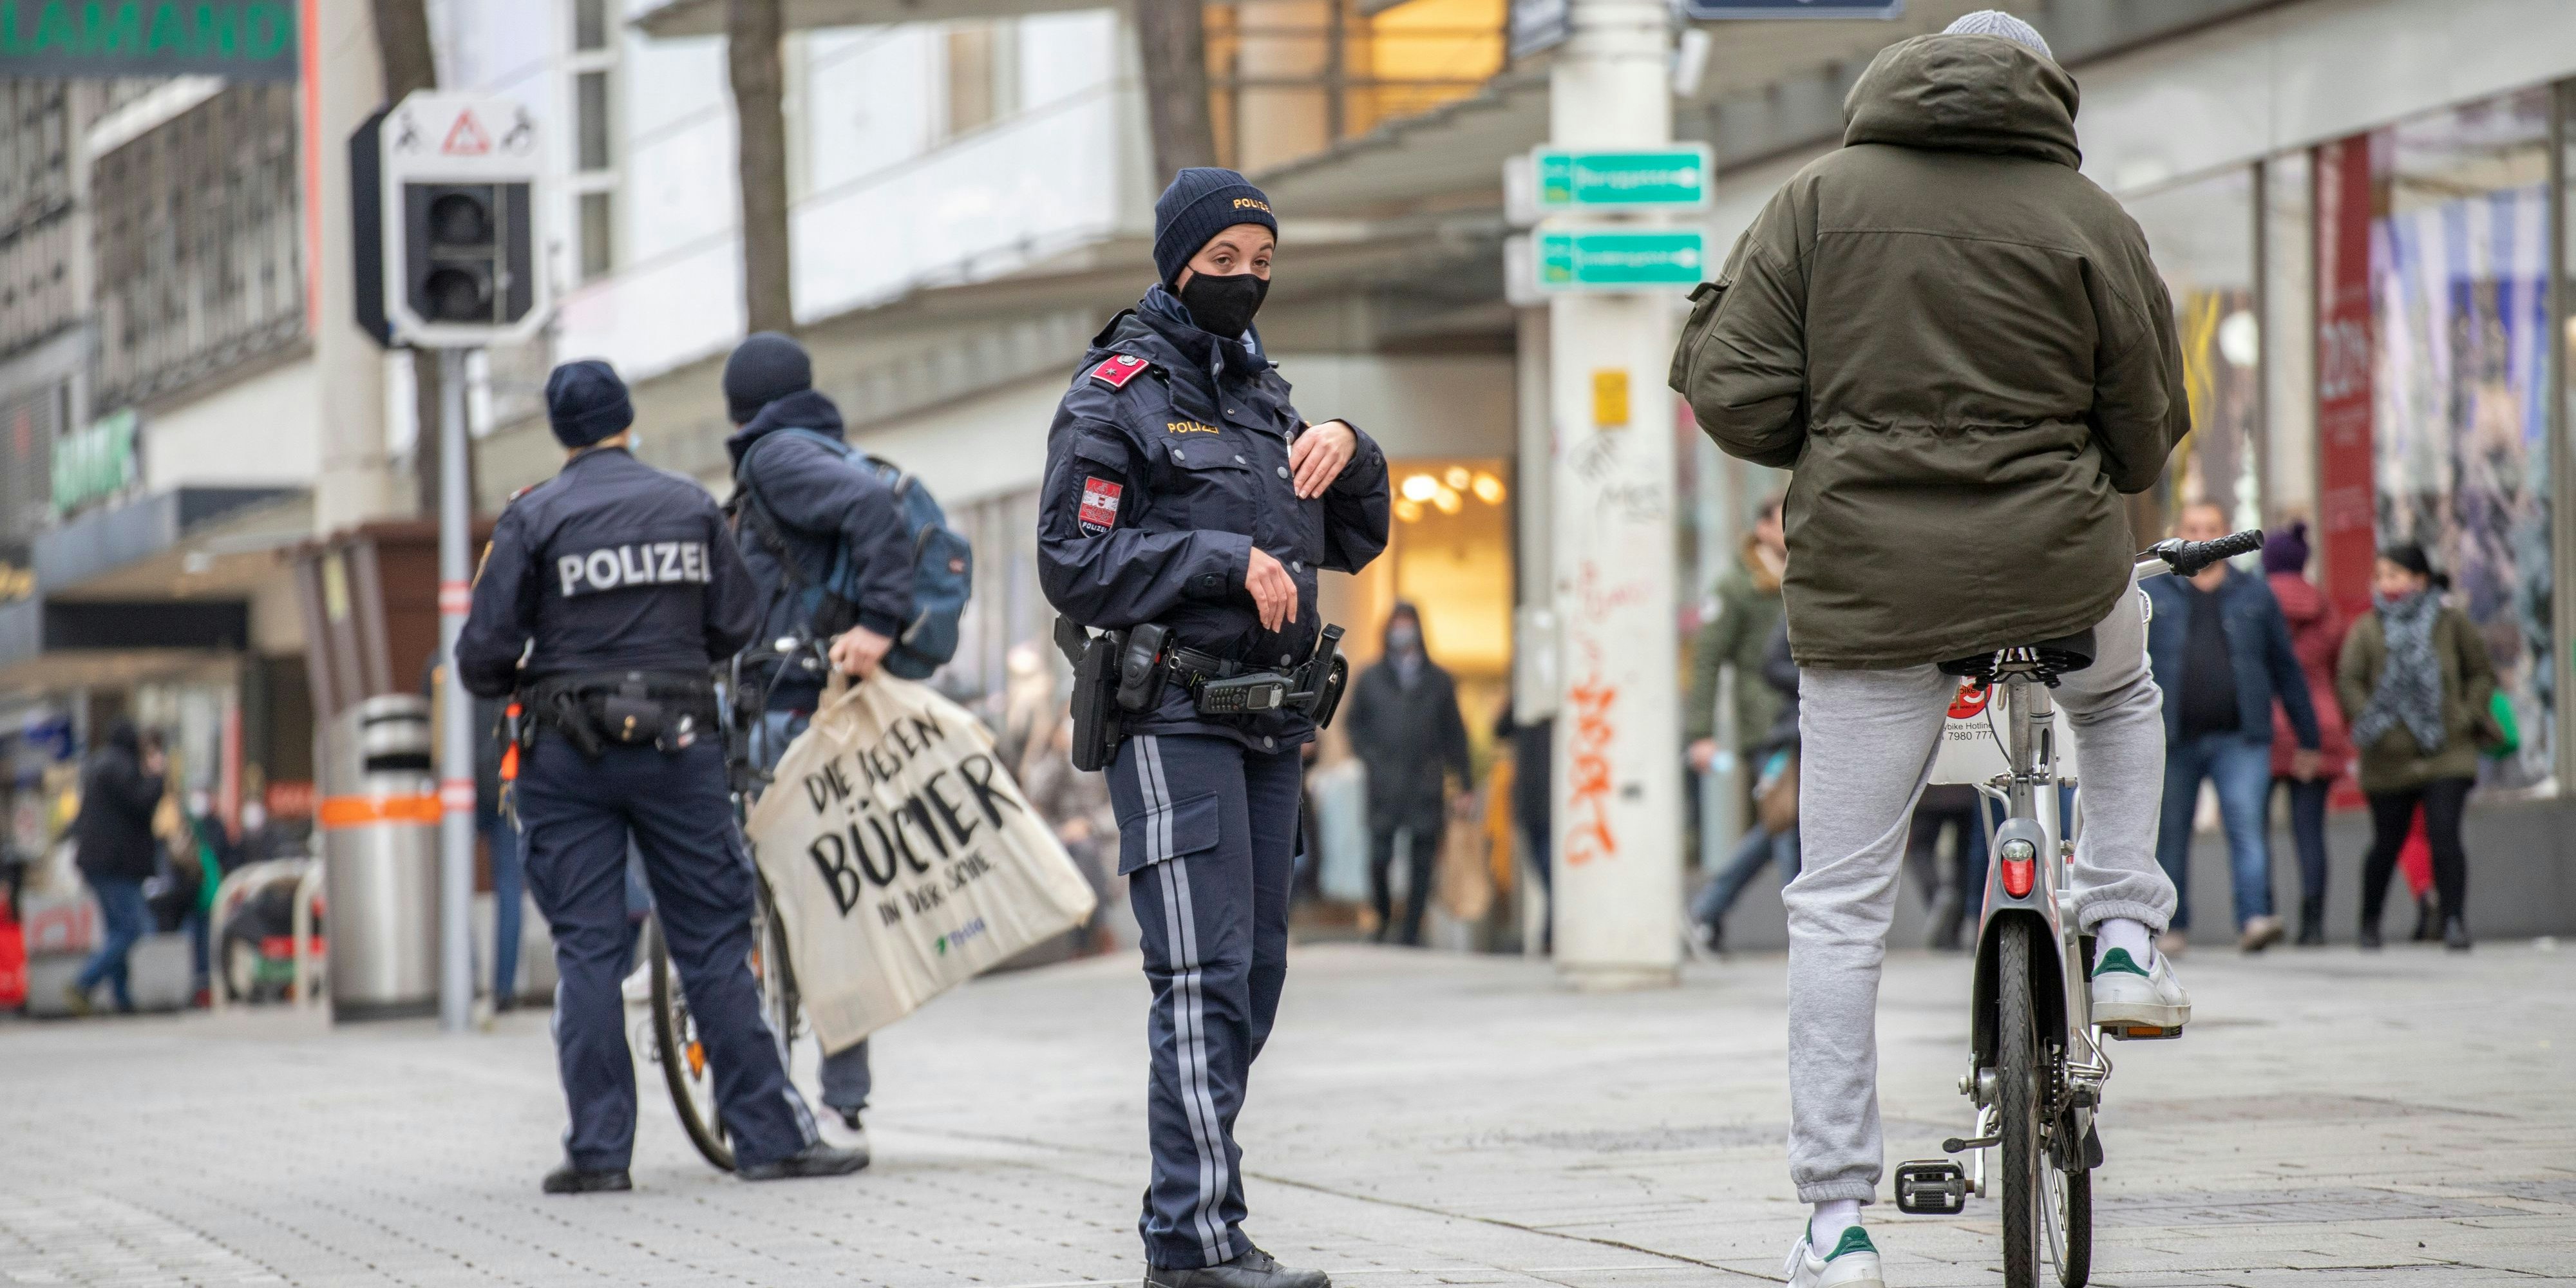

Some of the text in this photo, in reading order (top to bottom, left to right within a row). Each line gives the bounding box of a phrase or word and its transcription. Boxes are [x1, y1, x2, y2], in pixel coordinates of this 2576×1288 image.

[1082, 522, 1107, 533] POLIZEI
[558, 541, 712, 597] POLIZEI
[1948, 732, 1972, 741] 7980
[804, 755, 853, 815] DIE
